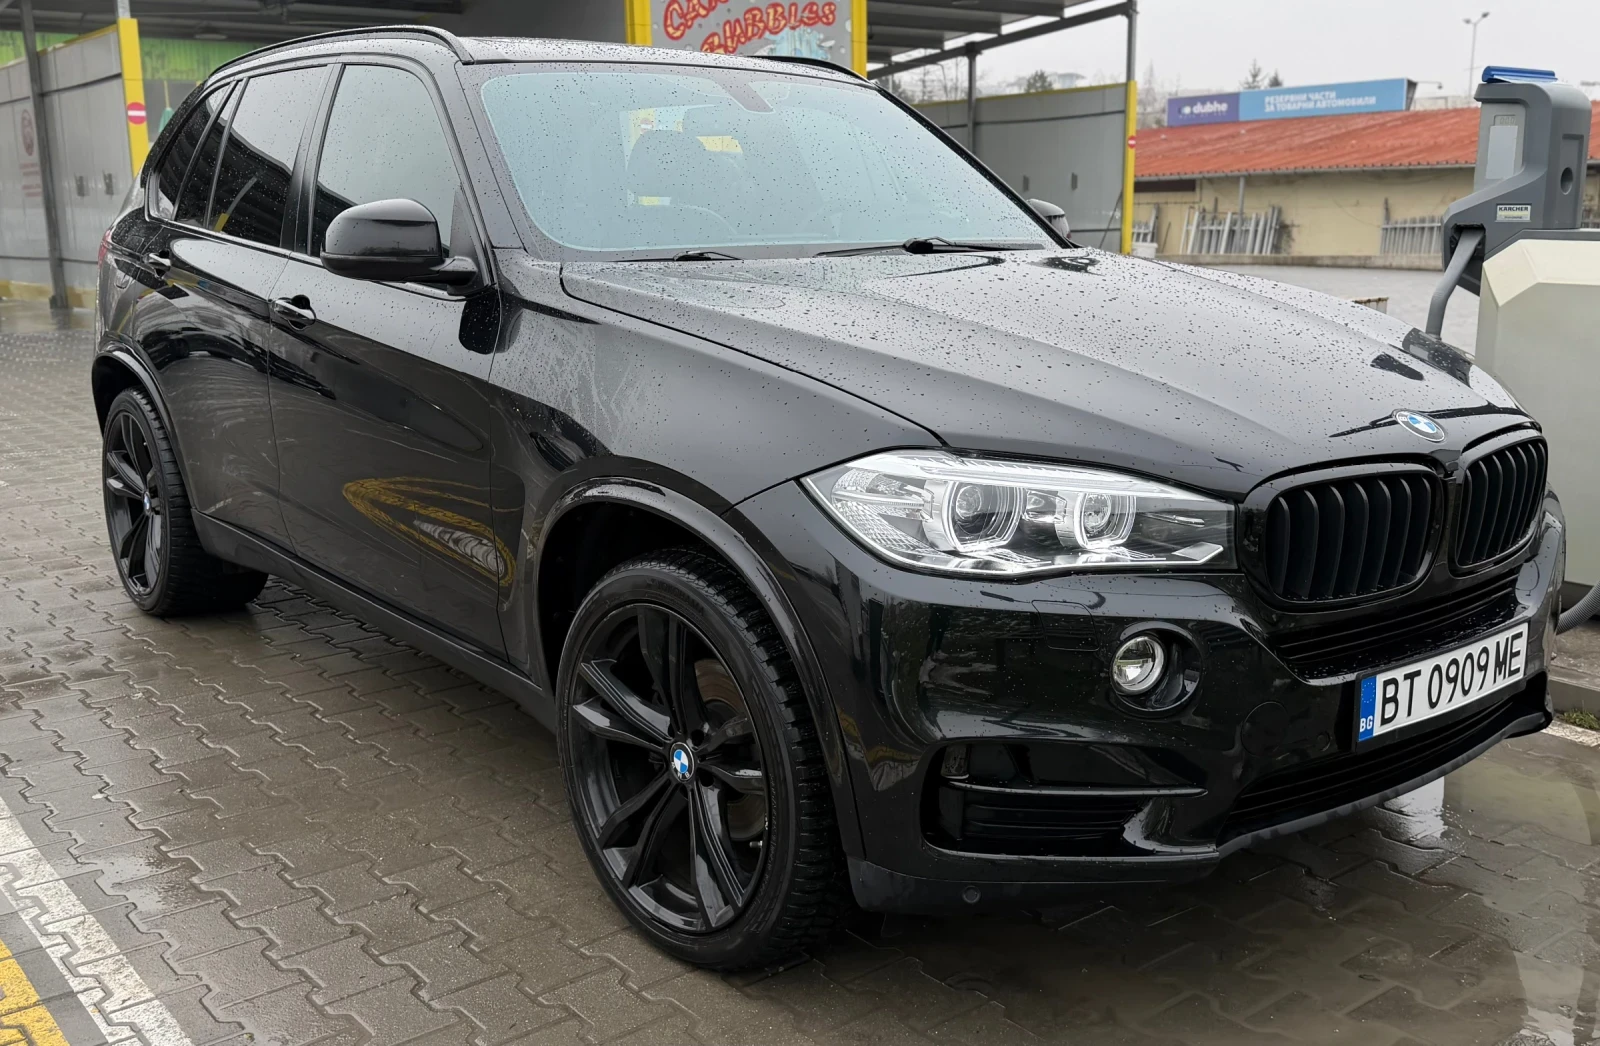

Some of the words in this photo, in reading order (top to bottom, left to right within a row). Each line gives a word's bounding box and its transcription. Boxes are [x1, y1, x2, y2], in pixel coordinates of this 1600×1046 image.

[1307, 90, 1336, 101] ЧАСТИ
[1192, 100, 1229, 114] dubhe
[1264, 102, 1276, 113] ЗА
[1380, 668, 1422, 727] BT
[1427, 646, 1490, 709] 0909
[1492, 631, 1524, 685] ME
[1359, 715, 1374, 733] BG
